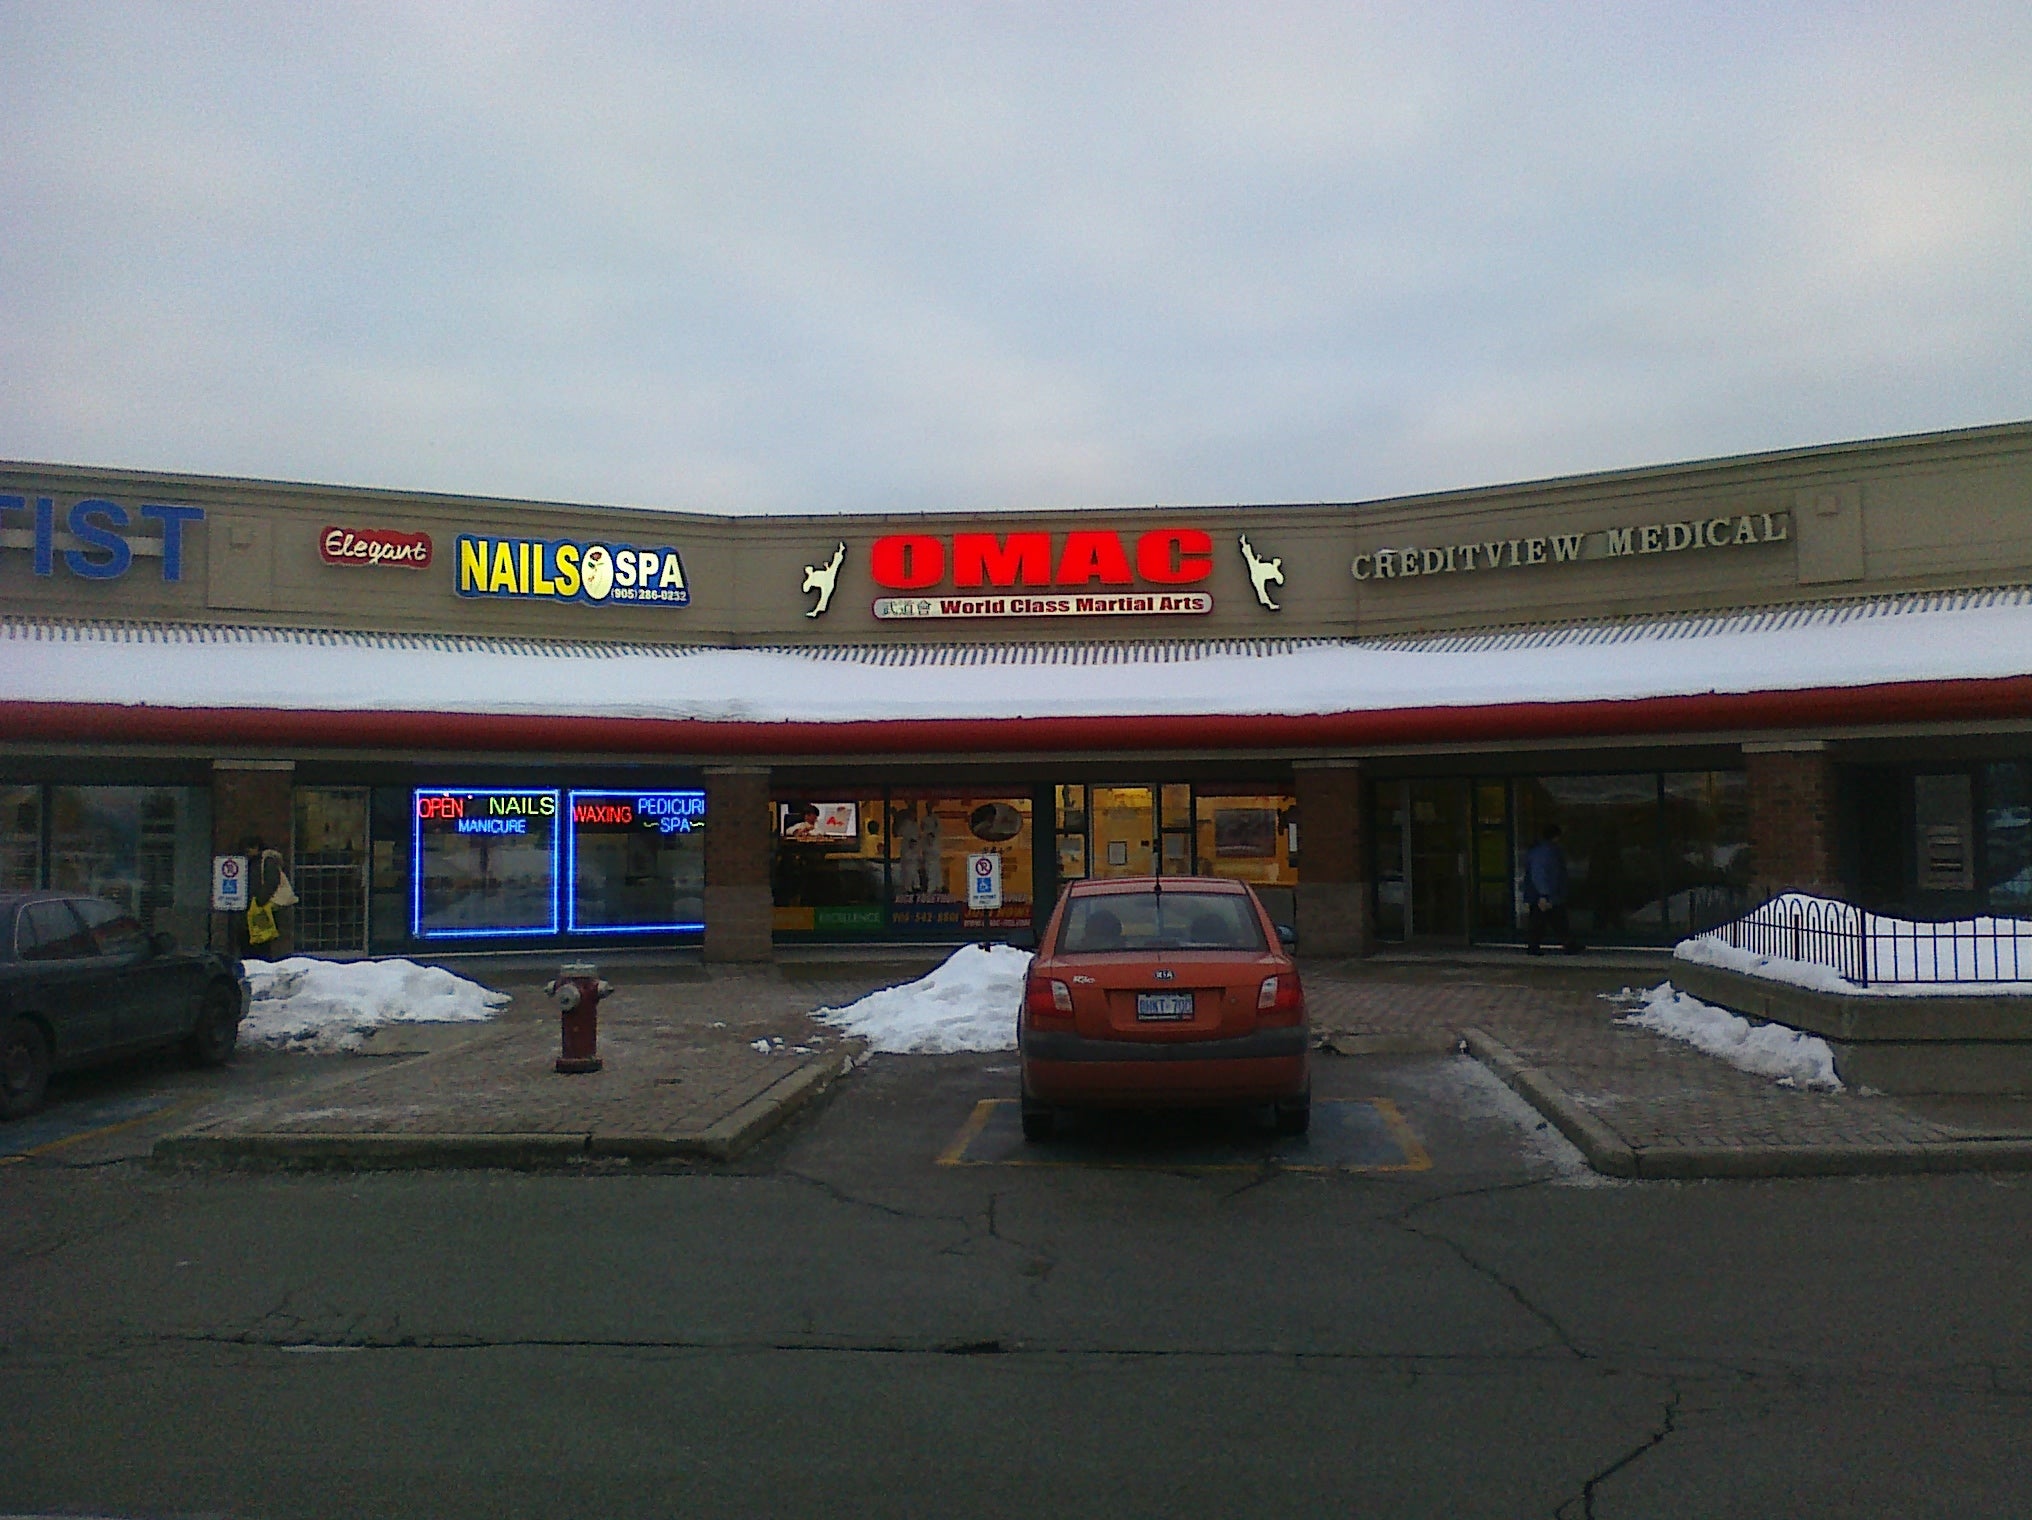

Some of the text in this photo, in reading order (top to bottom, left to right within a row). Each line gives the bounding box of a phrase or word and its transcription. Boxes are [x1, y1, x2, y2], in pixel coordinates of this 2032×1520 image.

[325, 529, 427, 564] Elegant
[1351, 513, 1787, 580] CREDITVIEW MEDICAL
[460, 539, 685, 597] NAILS SPA
[871, 528, 1213, 589] OMAC
[940, 596, 1204, 615] World Class Martial Arts
[418, 796, 555, 818] OPEN NAILS
[573, 804, 633, 824] WAXING
[458, 818, 526, 834] MANICURE
[660, 816, 691, 832] SPA
